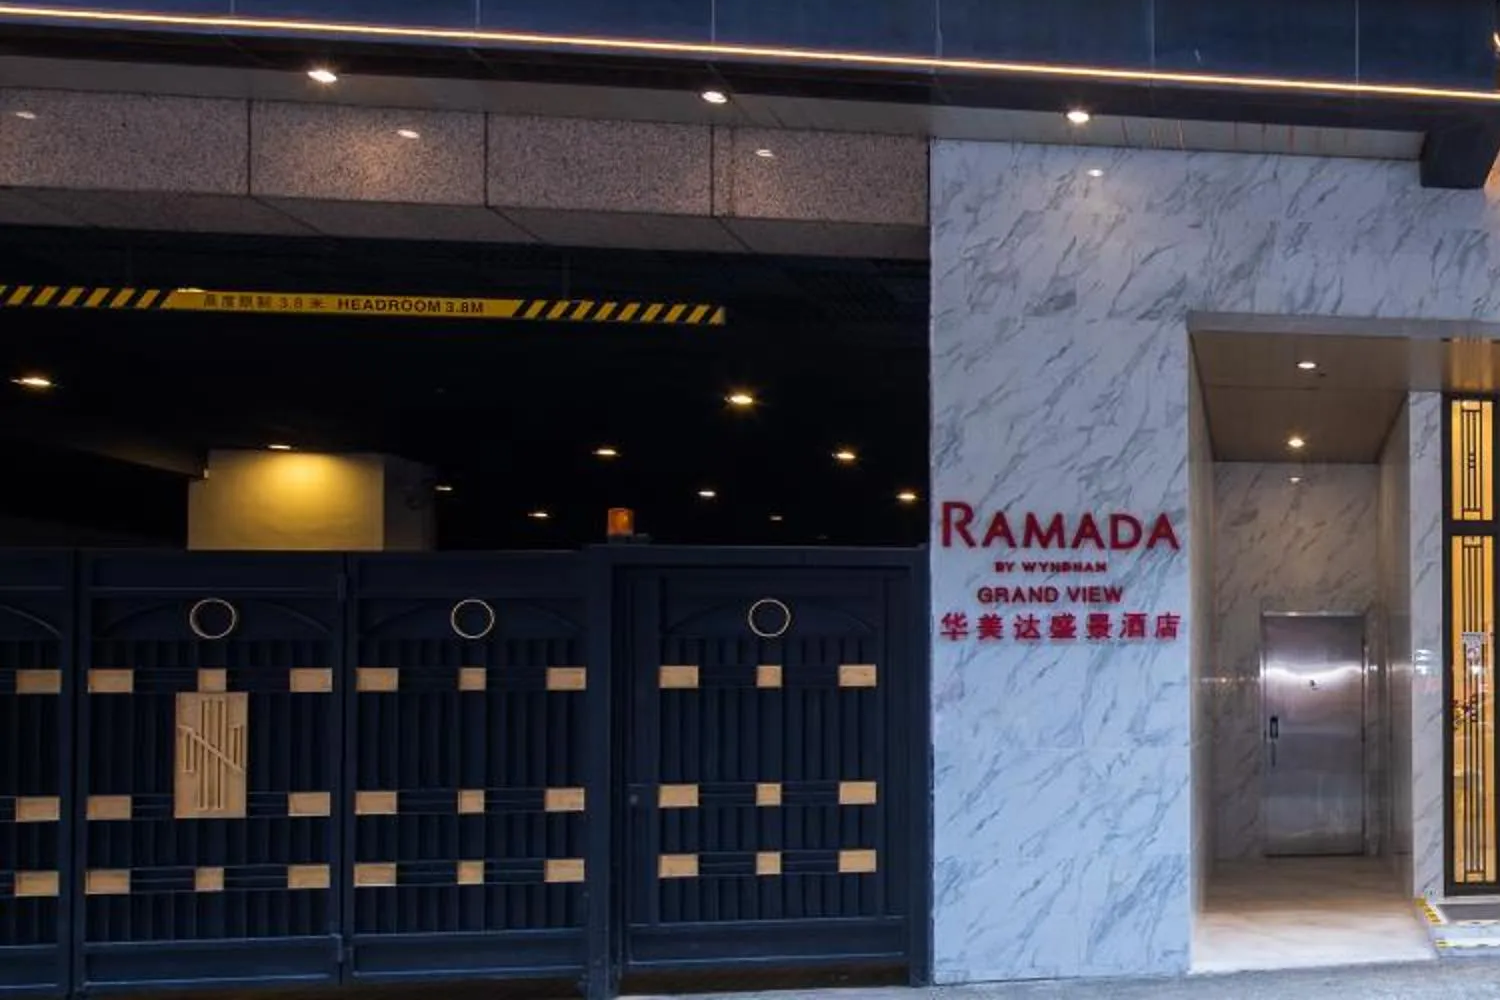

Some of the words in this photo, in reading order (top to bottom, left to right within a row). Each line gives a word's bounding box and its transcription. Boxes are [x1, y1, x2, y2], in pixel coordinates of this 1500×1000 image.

[337, 297, 441, 314] HEADROOM
[445, 300, 485, 314] 3.8M
[941, 501, 1180, 550] RAMADA
[995, 561, 1015, 573] BY
[1021, 561, 1107, 573] WYNDHAM
[977, 586, 1059, 603] GRAND
[1066, 586, 1124, 602] VIEW
[940, 611, 1181, 641] 华美达盛景酒店
